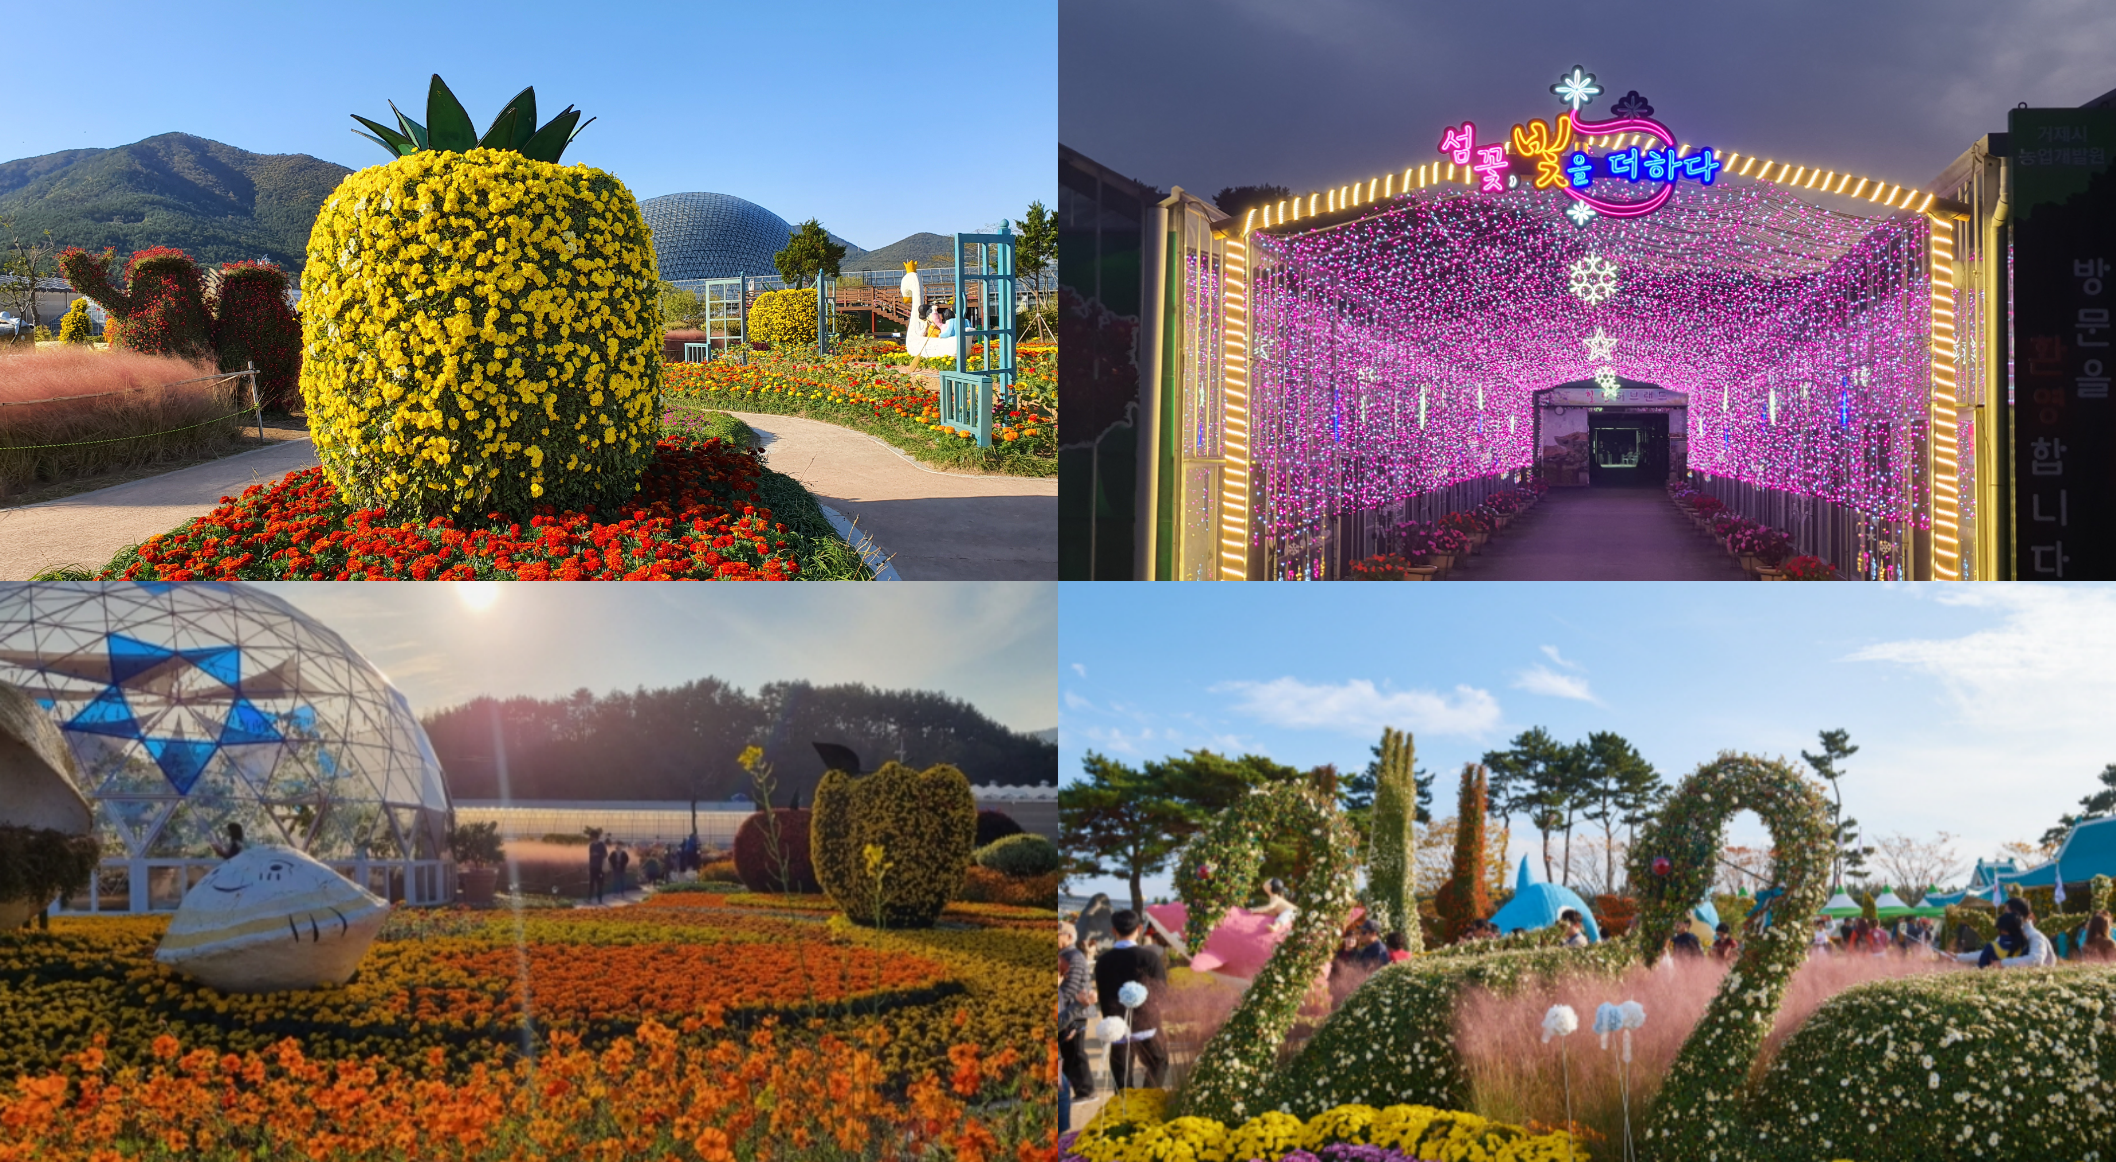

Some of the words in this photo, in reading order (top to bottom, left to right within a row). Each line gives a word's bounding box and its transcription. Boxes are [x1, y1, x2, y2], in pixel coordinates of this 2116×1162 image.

[1513, 115, 1592, 189] 빛을
[1608, 147, 1720, 183] 더하다
[2018, 147, 2105, 166] 농업개발원
[2037, 125, 2088, 143] 거제시
[2074, 257, 2111, 398] 방문을
